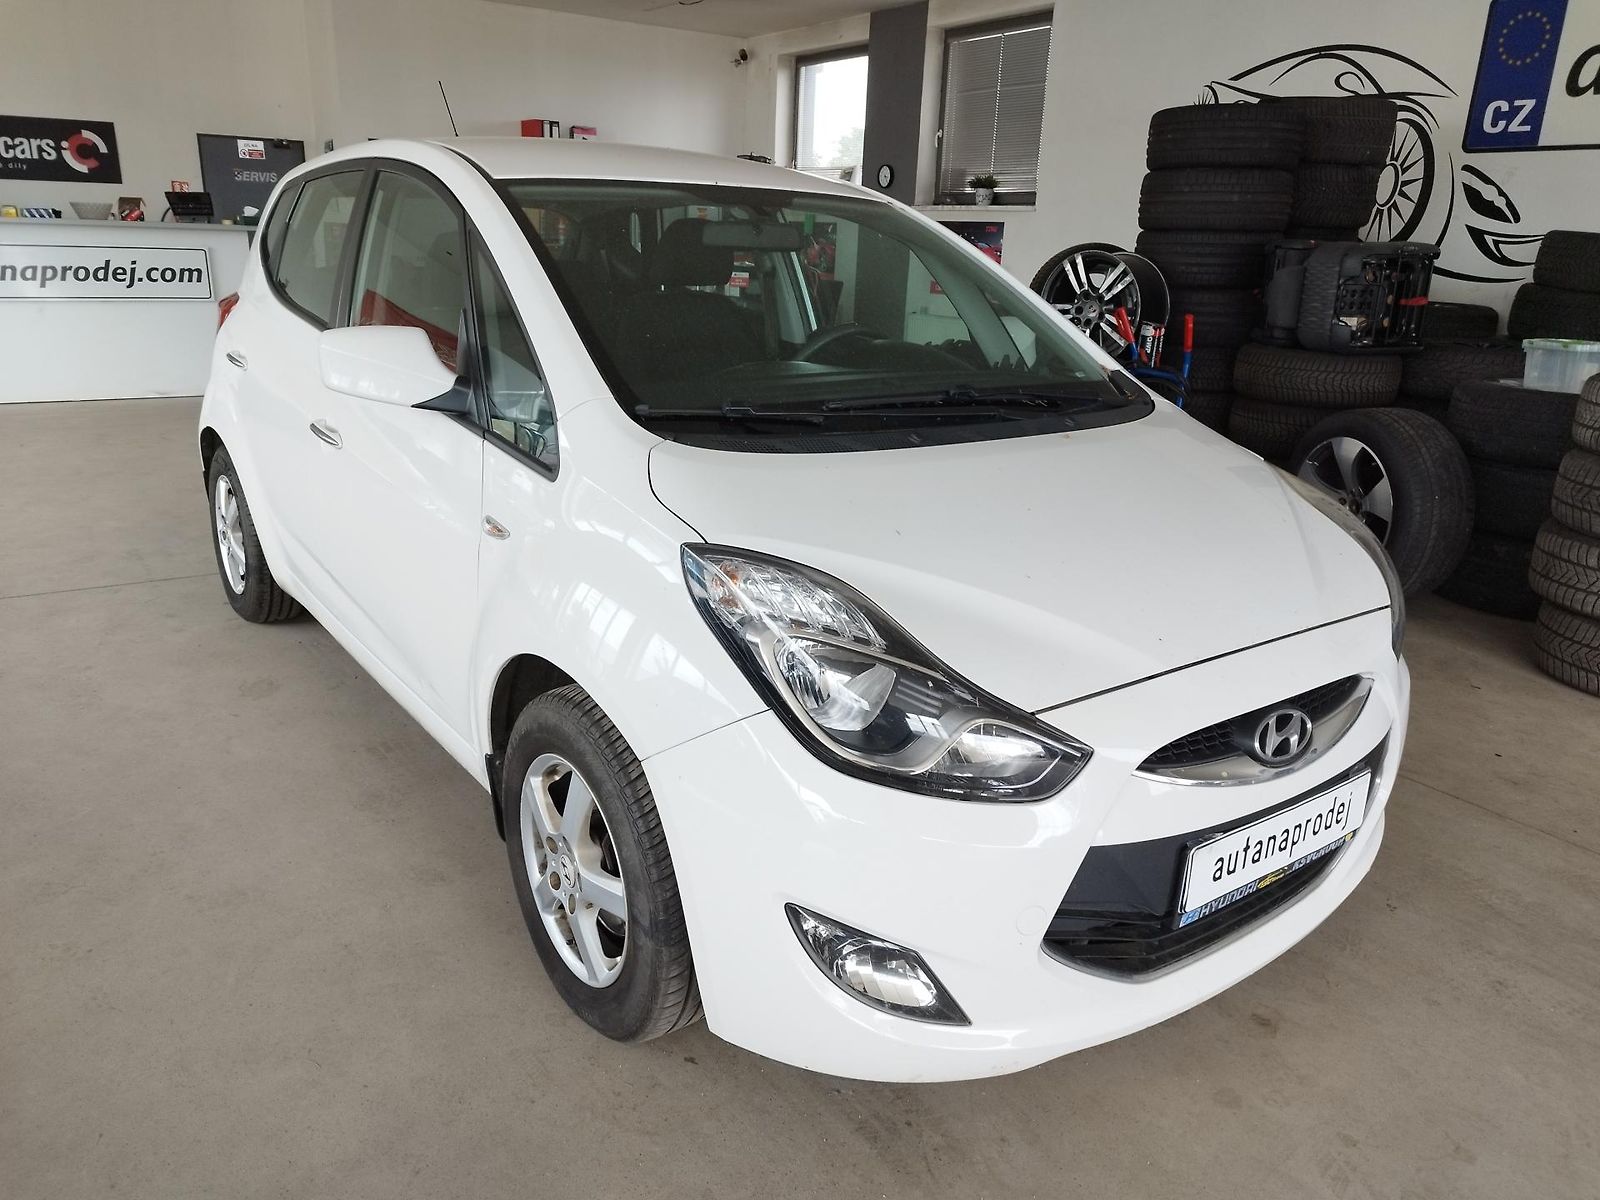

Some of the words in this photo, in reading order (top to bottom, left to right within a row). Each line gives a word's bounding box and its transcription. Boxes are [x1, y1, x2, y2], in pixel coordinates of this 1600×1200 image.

[1482, 99, 1536, 134] CZ
[234, 170, 279, 183] SERVIS
[0, 259, 203, 289] naprodej.com
[1212, 791, 1353, 882] autanaprodej
[1199, 879, 1258, 918] HYUNDAI
